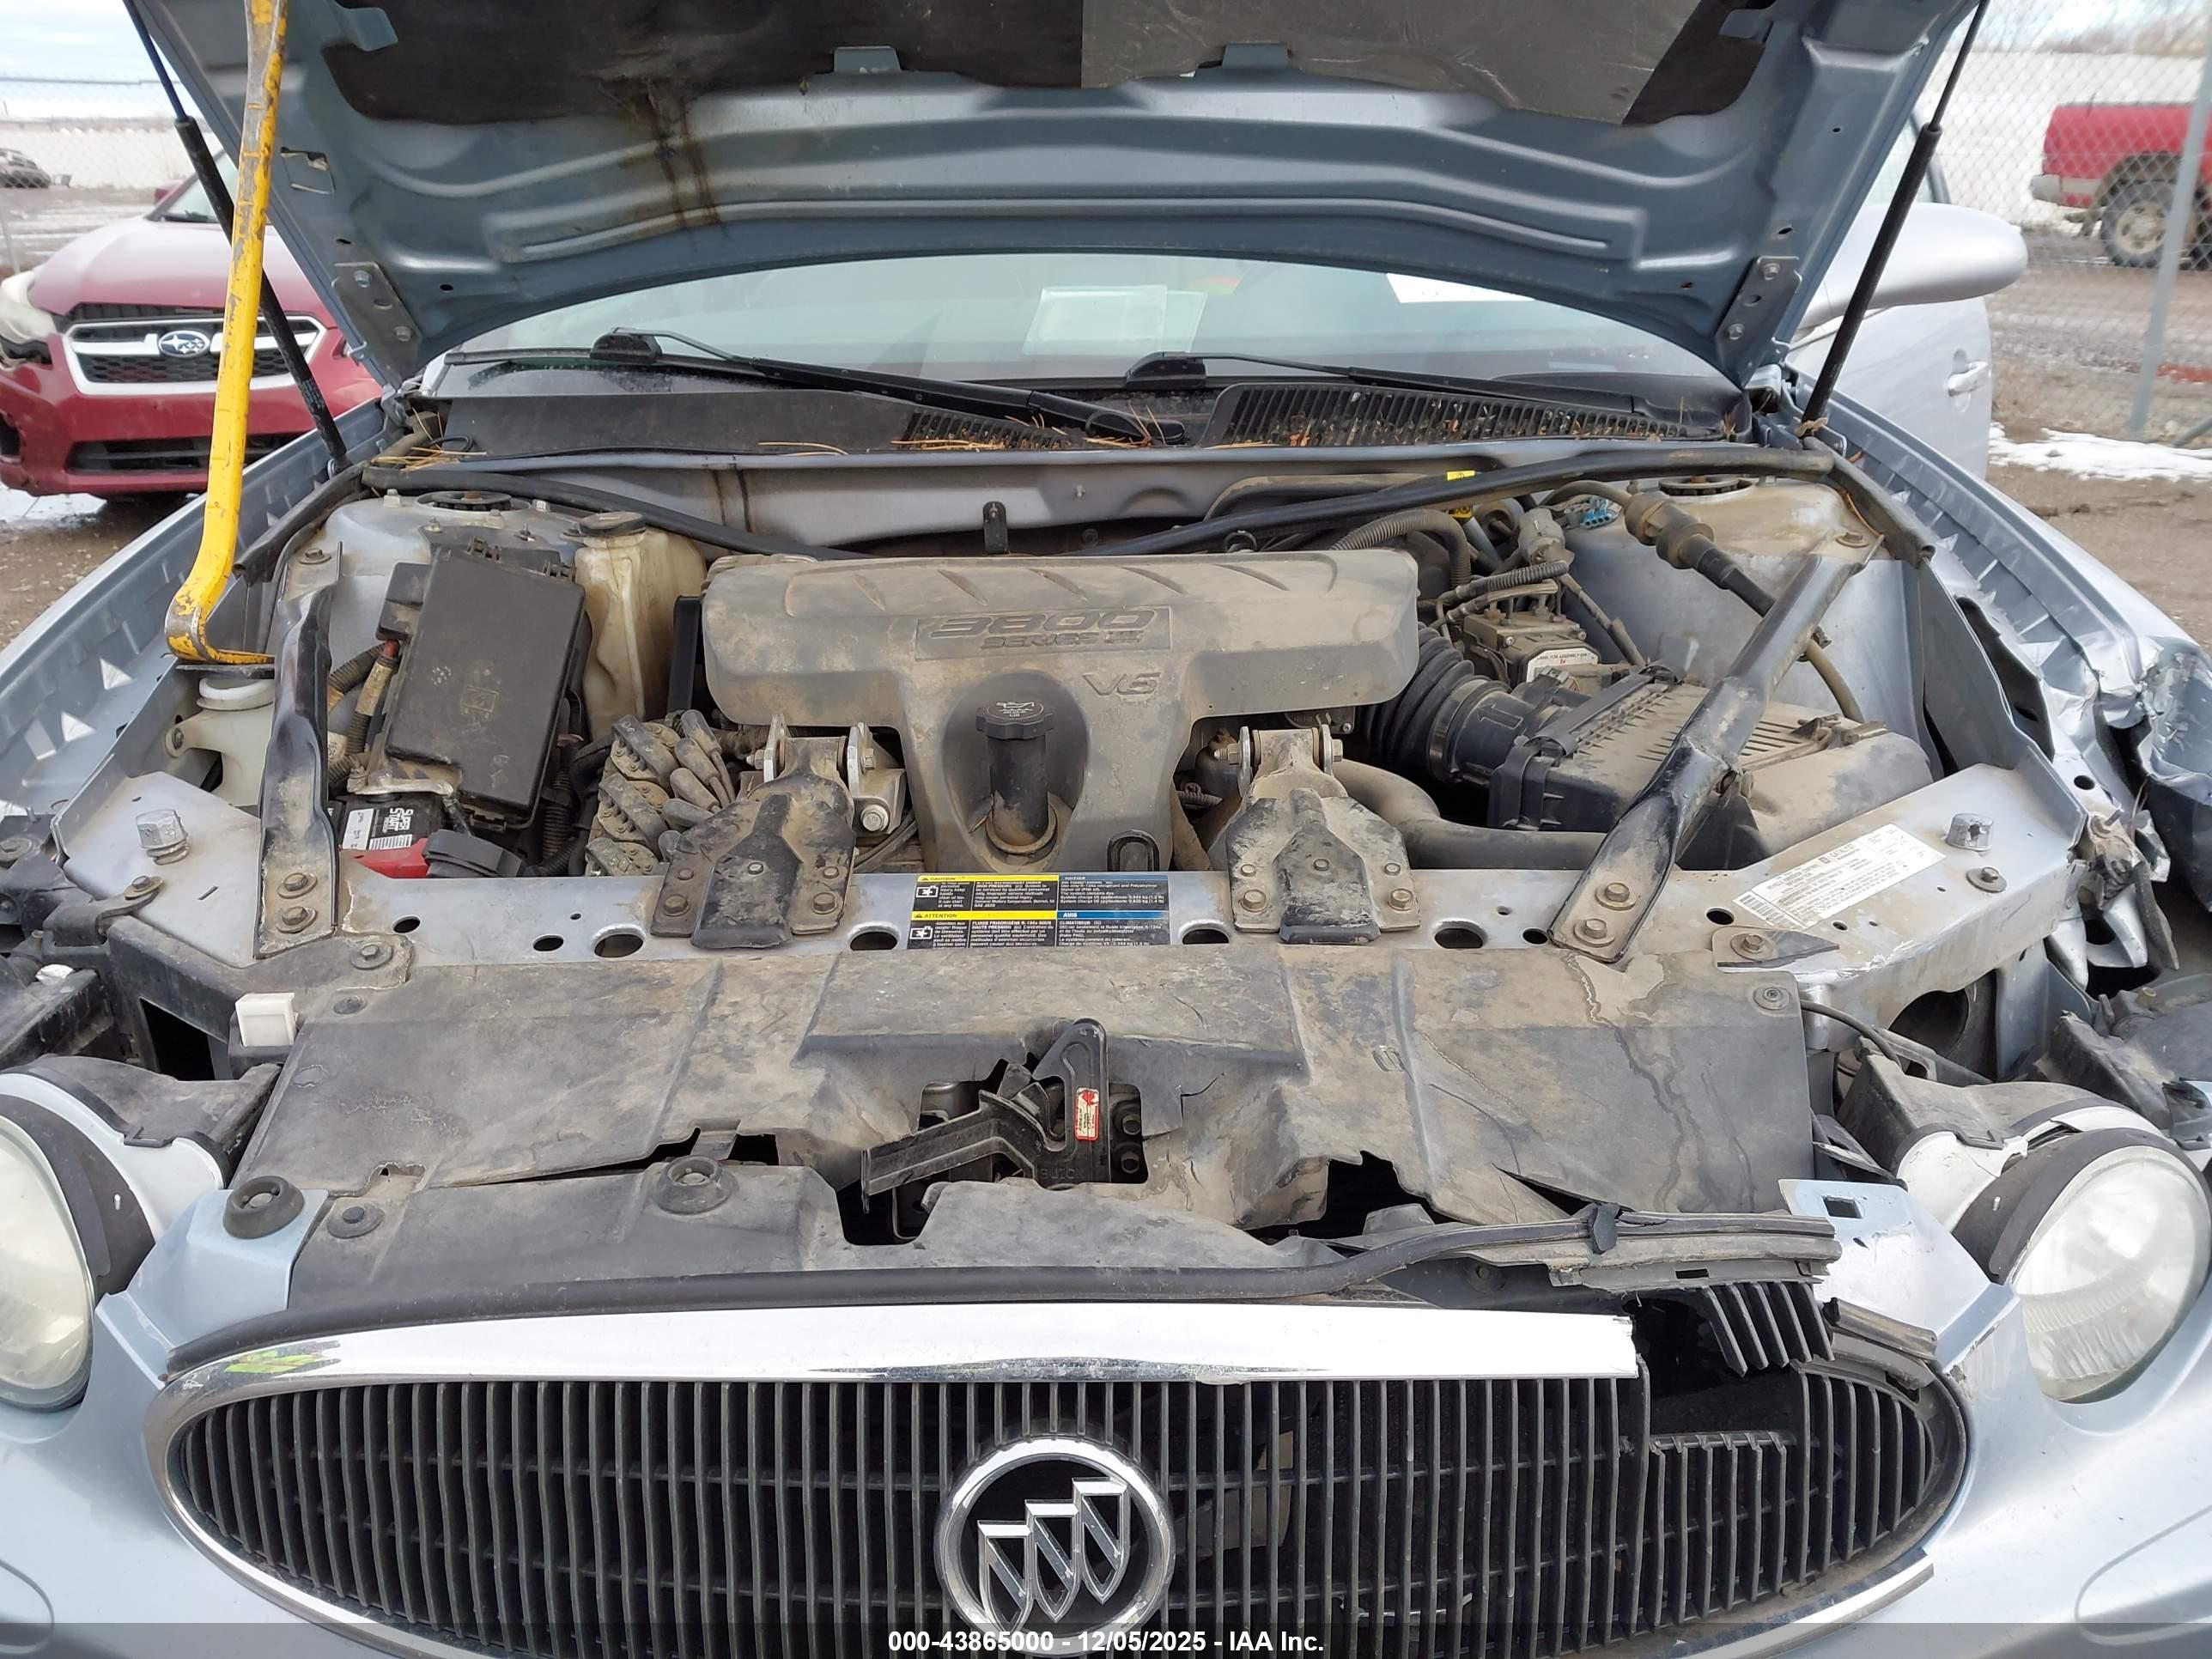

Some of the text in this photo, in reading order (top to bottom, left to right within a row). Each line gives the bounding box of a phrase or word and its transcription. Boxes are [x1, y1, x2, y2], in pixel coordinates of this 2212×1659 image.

[931, 611, 1155, 639] 3800
[1082, 672, 1161, 696] V6
[388, 807, 404, 831] START
[398, 808, 414, 830] SUPER
